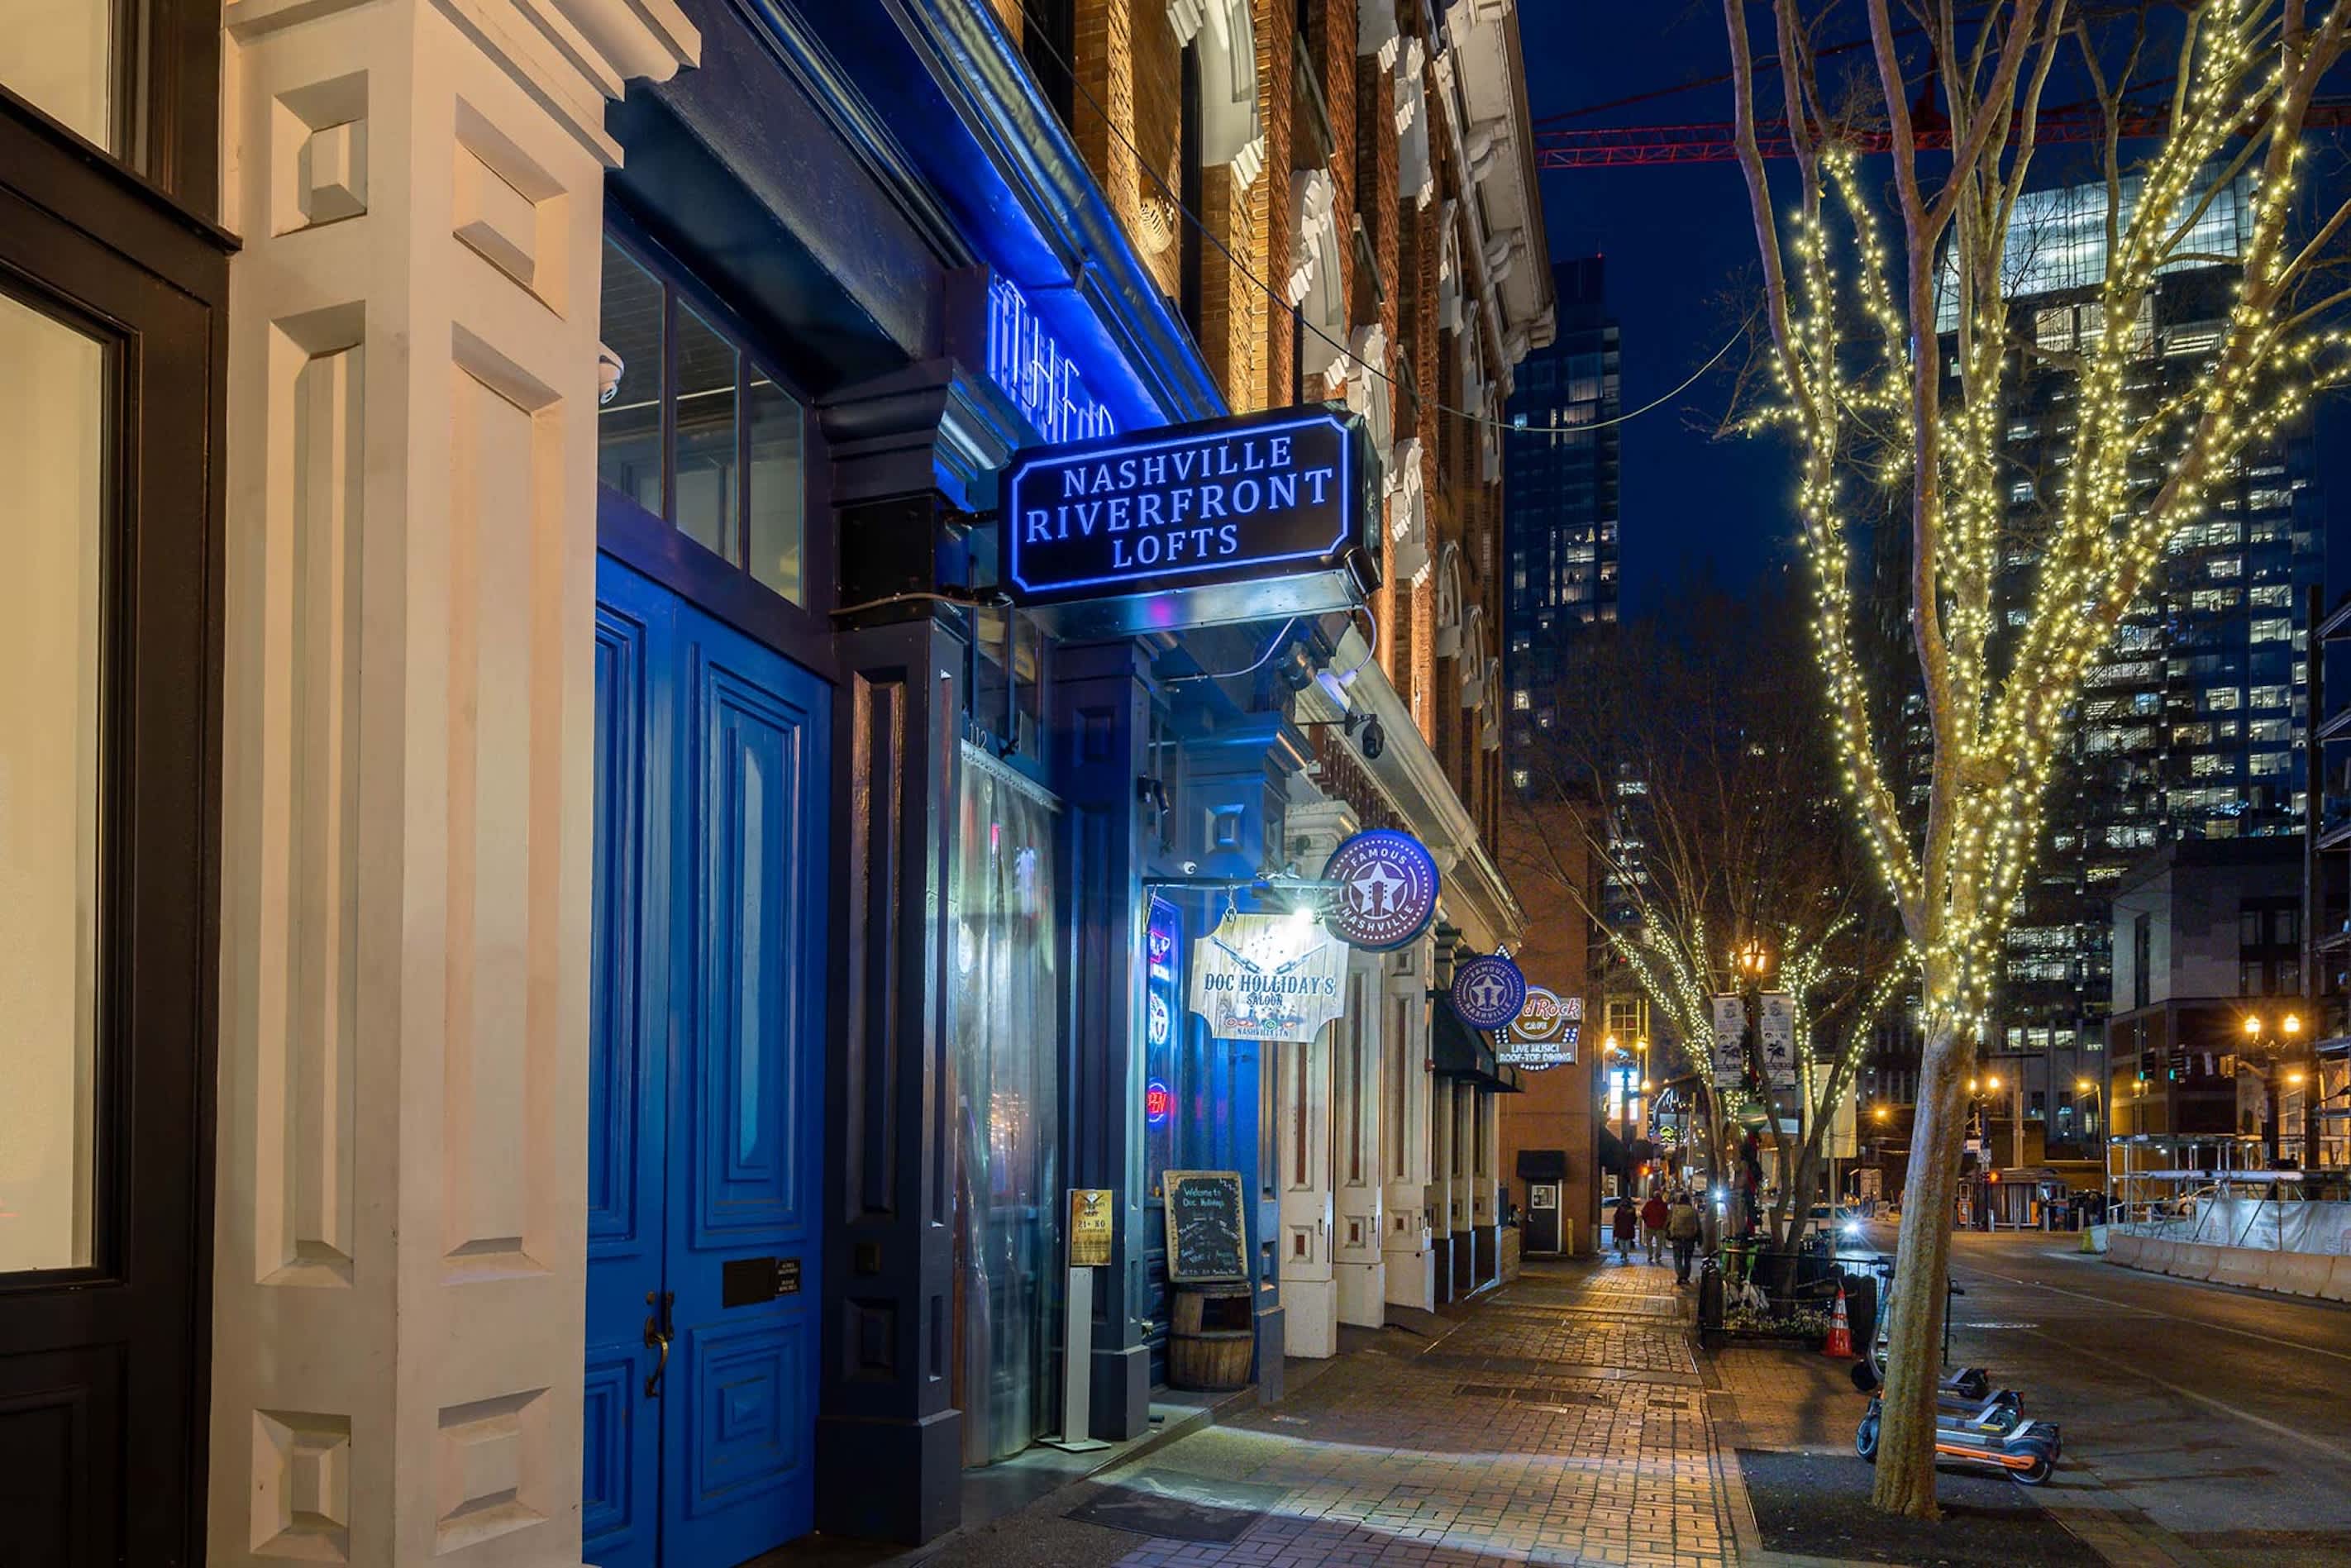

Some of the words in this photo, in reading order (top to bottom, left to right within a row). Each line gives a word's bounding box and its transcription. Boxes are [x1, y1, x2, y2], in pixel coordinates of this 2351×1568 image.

[1064, 436, 1291, 498] NASHVILLE
[1026, 468, 1333, 543] RIVERFRONT
[1113, 524, 1237, 569] LOFTS
[970, 723, 987, 753] 112
[1350, 848, 1407, 867] FAMOUS
[1342, 905, 1414, 932] NASHVILLE
[1204, 974, 1234, 991] DOC
[1247, 994, 1283, 1006] SALOON
[1536, 998, 1579, 1019] Rock
[1500, 1053, 1541, 1062] ROOF-TOP
